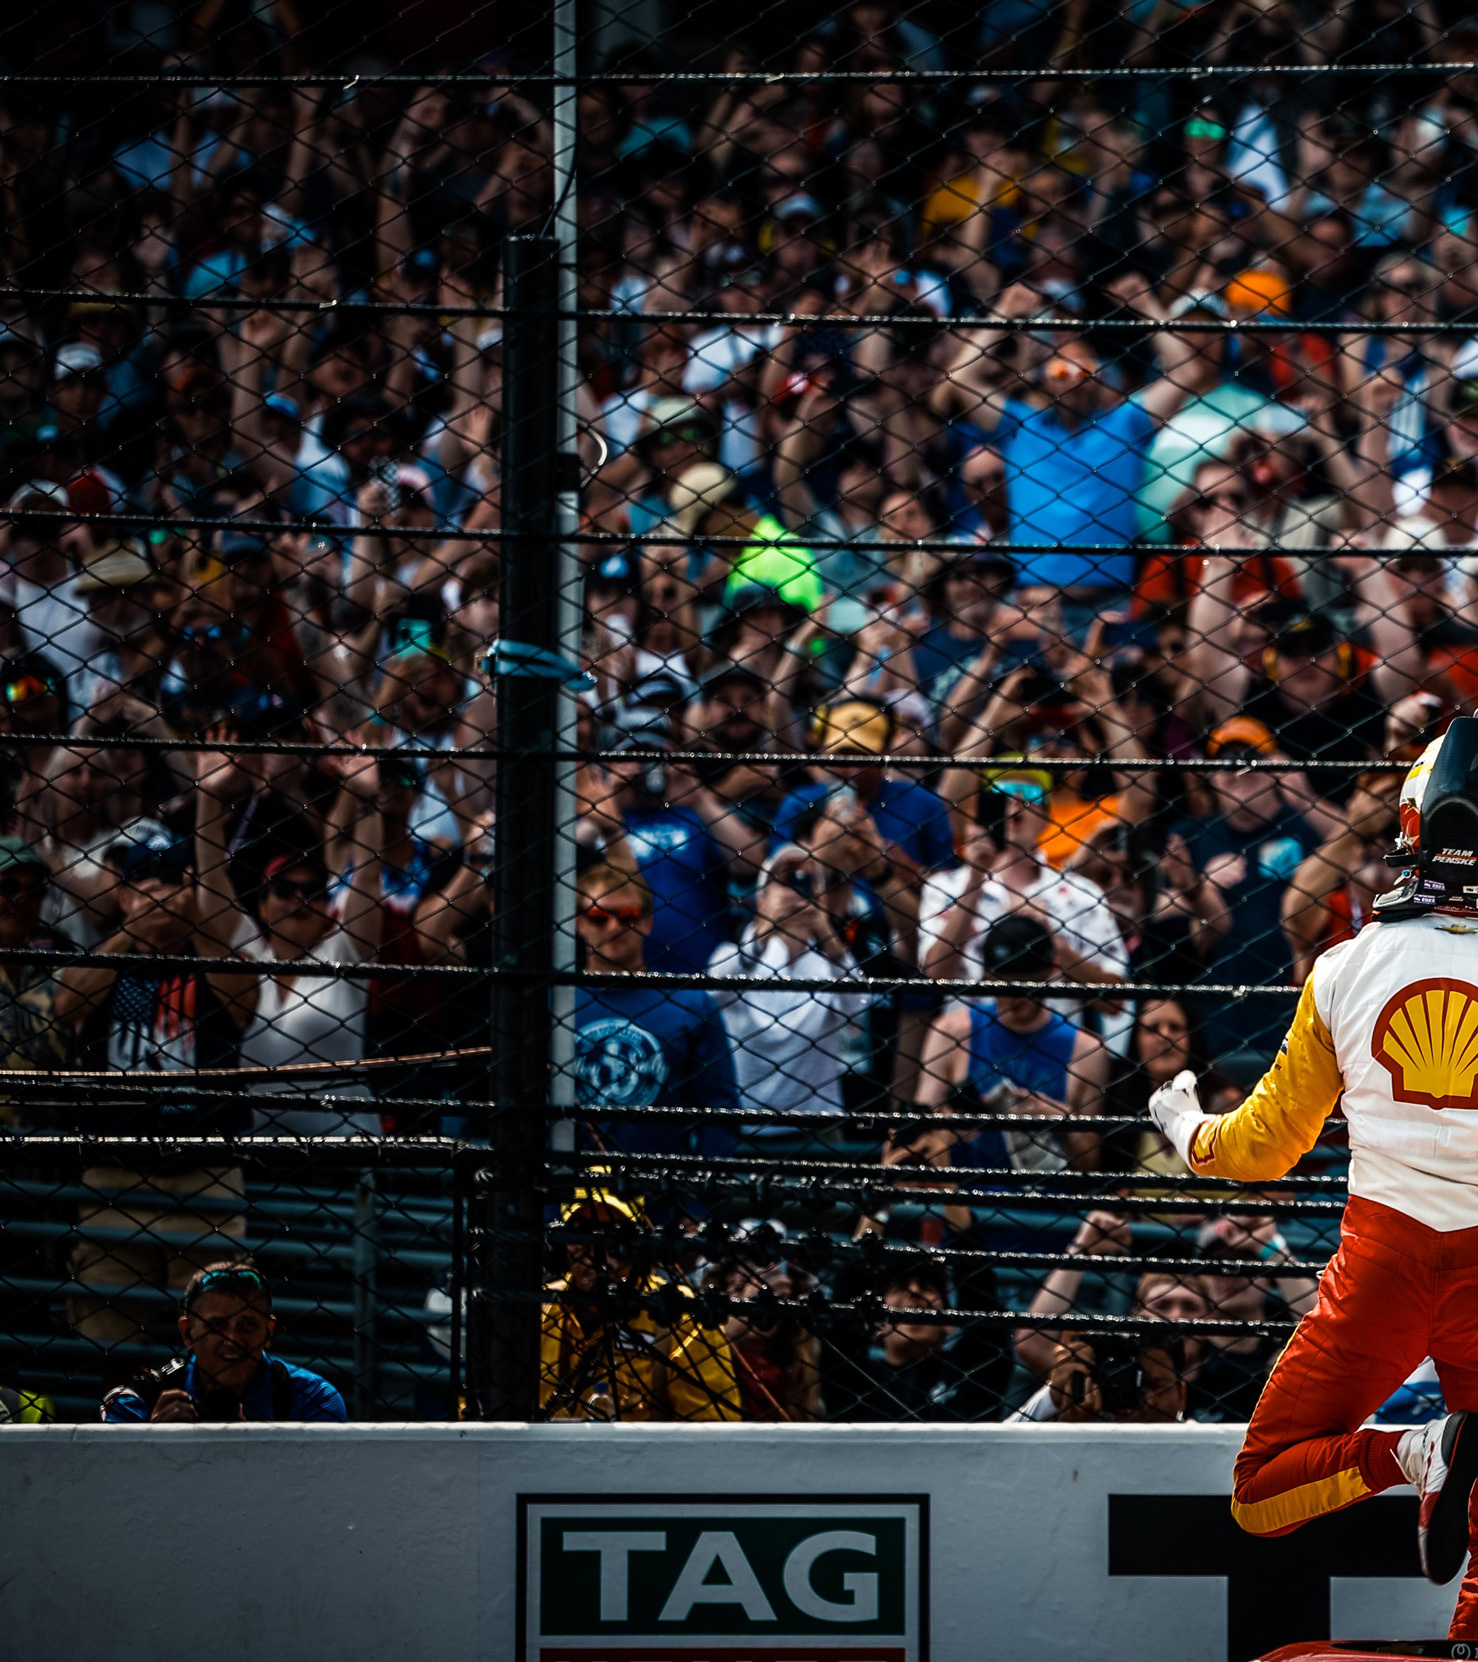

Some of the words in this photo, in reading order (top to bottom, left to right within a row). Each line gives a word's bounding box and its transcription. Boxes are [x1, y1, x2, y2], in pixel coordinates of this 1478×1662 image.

[1441, 848, 1473, 858] TEAM
[1432, 855, 1477, 866] PENSKE
[562, 1530, 880, 1622] TAG
